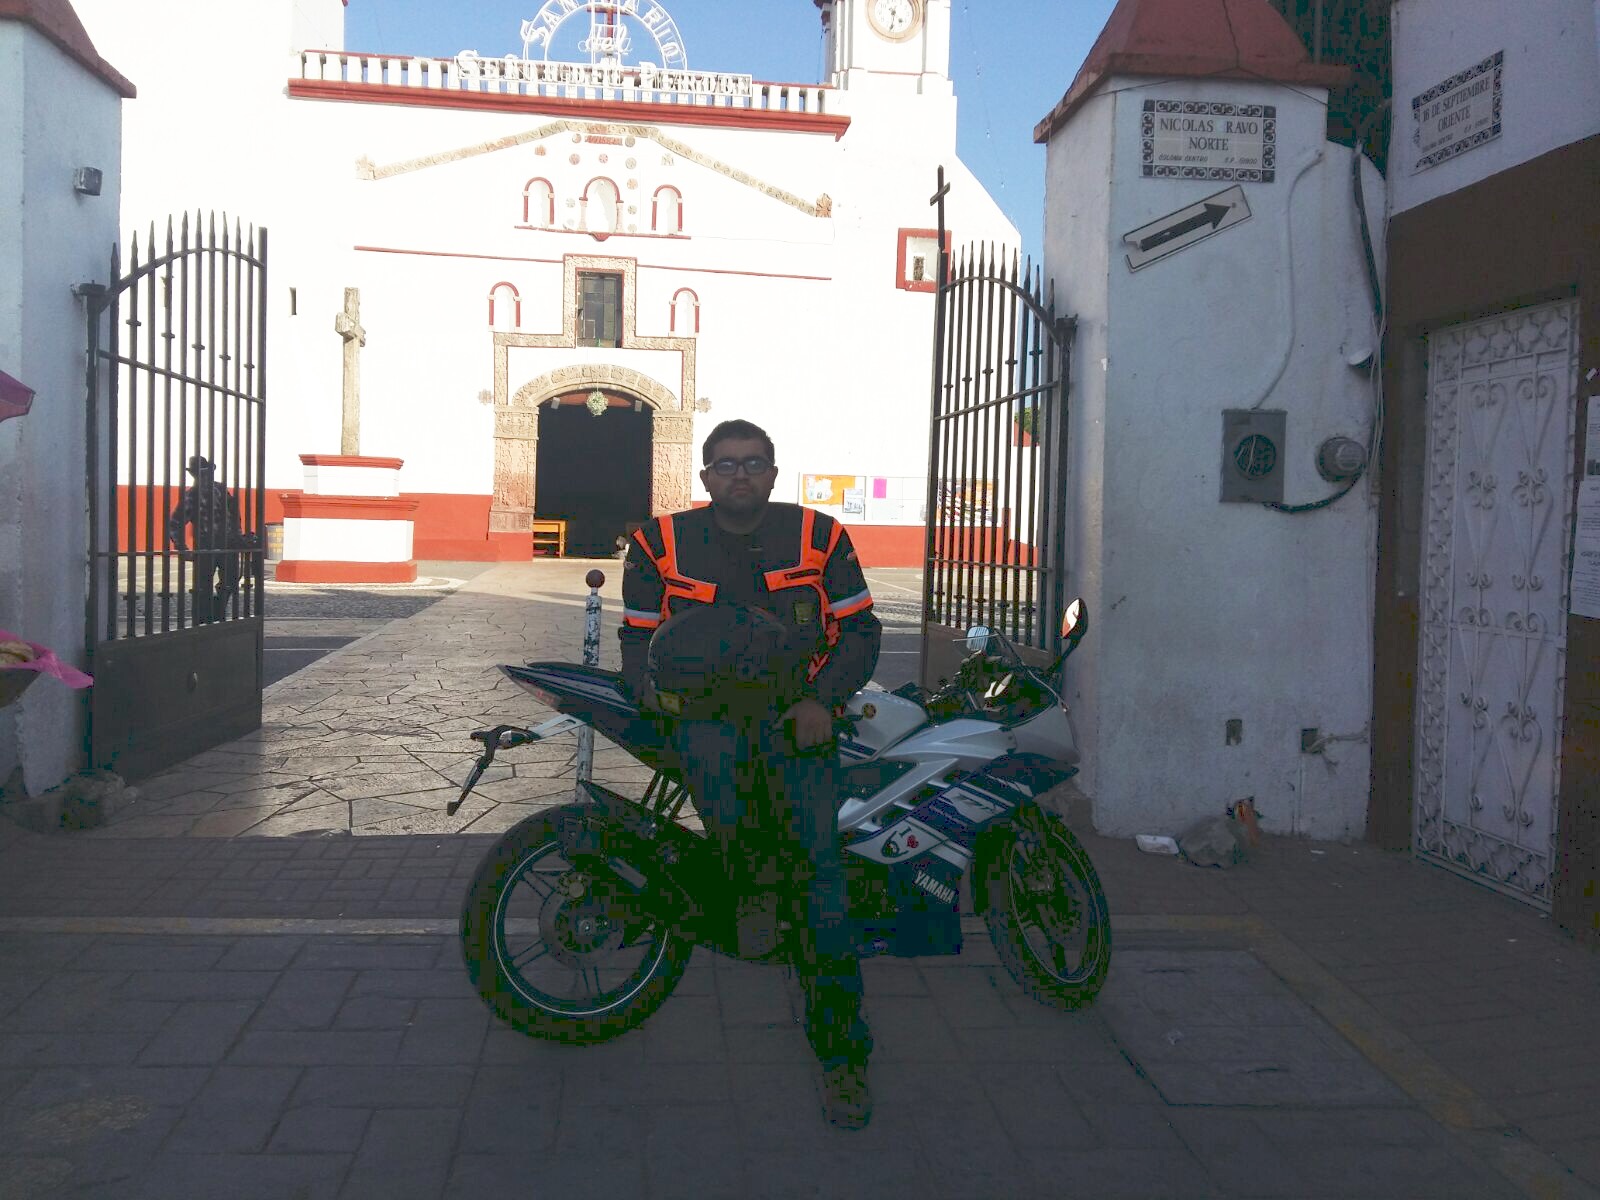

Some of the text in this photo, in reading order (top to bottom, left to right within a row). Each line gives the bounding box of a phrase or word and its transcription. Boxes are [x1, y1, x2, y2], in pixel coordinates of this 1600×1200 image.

[520, 0, 685, 64] SANARIO
[1423, 76, 1491, 122] 16 DE SEPTIEMBRE
[1160, 117, 1258, 135] NICOLAS RAVO
[1438, 104, 1471, 132] ORIENTE
[1188, 136, 1229, 151] NORTE
[913, 869, 956, 904] YAMAHA
